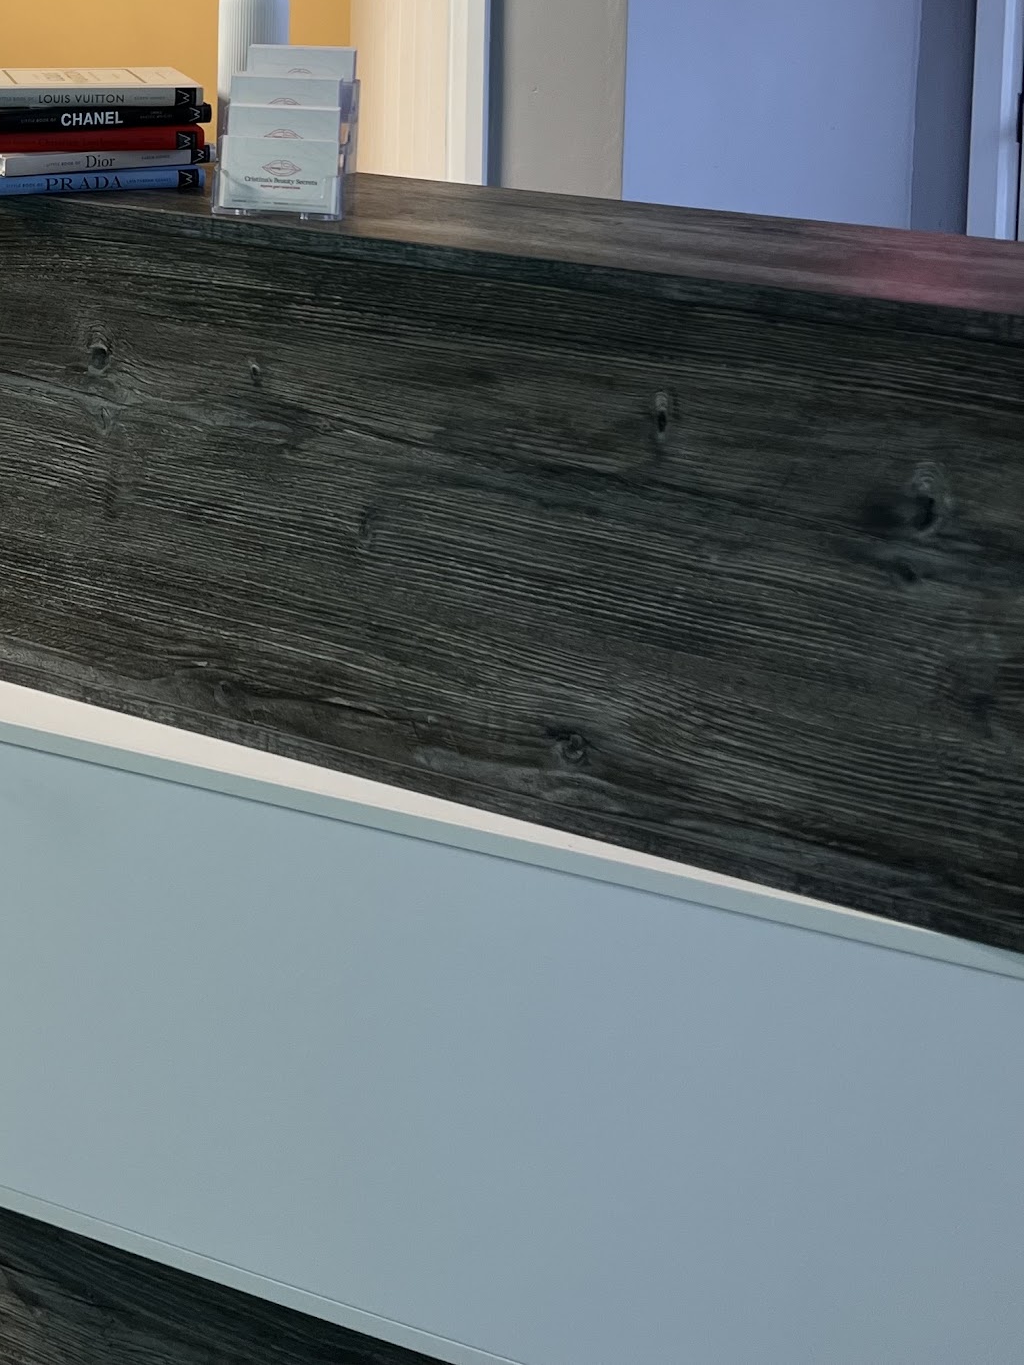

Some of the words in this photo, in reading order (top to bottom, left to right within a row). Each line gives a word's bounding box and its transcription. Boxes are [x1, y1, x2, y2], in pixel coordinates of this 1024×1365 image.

[38, 94, 71, 104] LOUIS
[75, 94, 125, 104] VUITTON
[61, 111, 124, 127] CHANEL
[85, 154, 116, 169] Dior
[45, 175, 123, 192] PRADA
